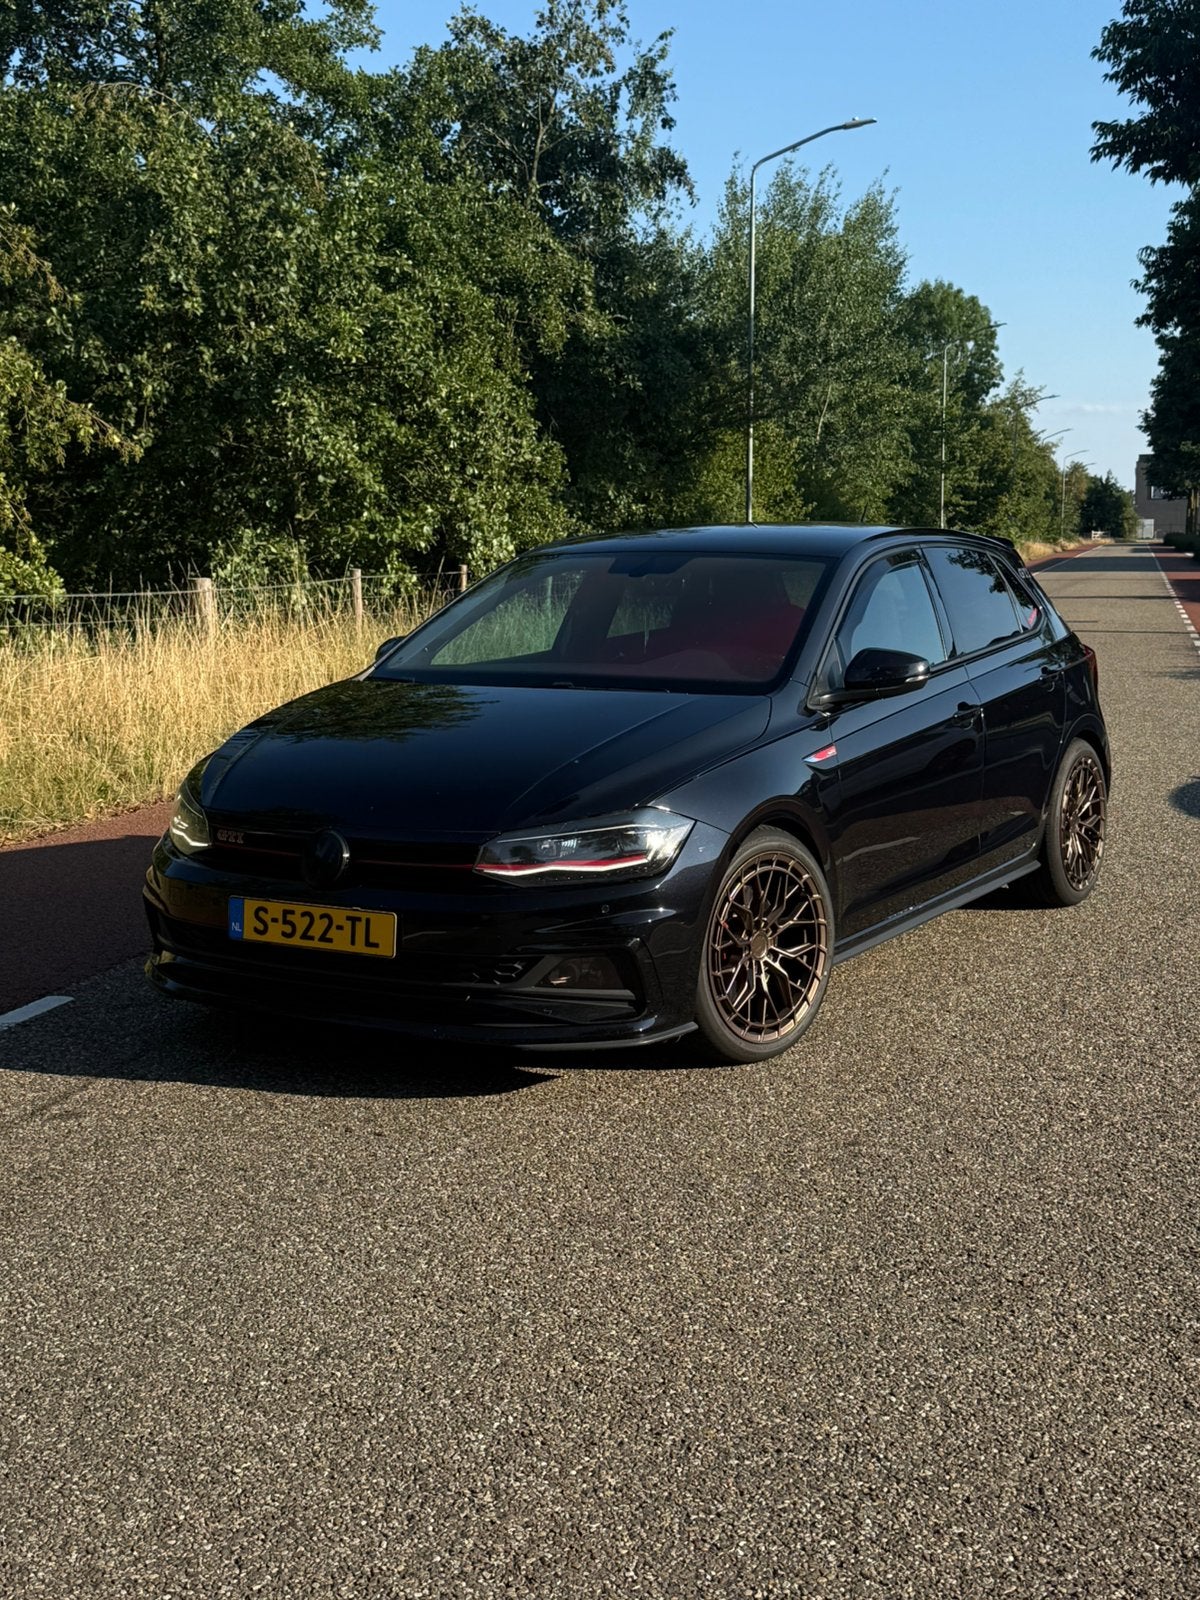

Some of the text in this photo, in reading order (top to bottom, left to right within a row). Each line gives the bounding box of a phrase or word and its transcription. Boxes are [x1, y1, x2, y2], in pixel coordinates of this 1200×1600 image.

[217, 829, 244, 844] GTI
[231, 921, 242, 932] NL
[253, 906, 380, 948] S-522-TL
